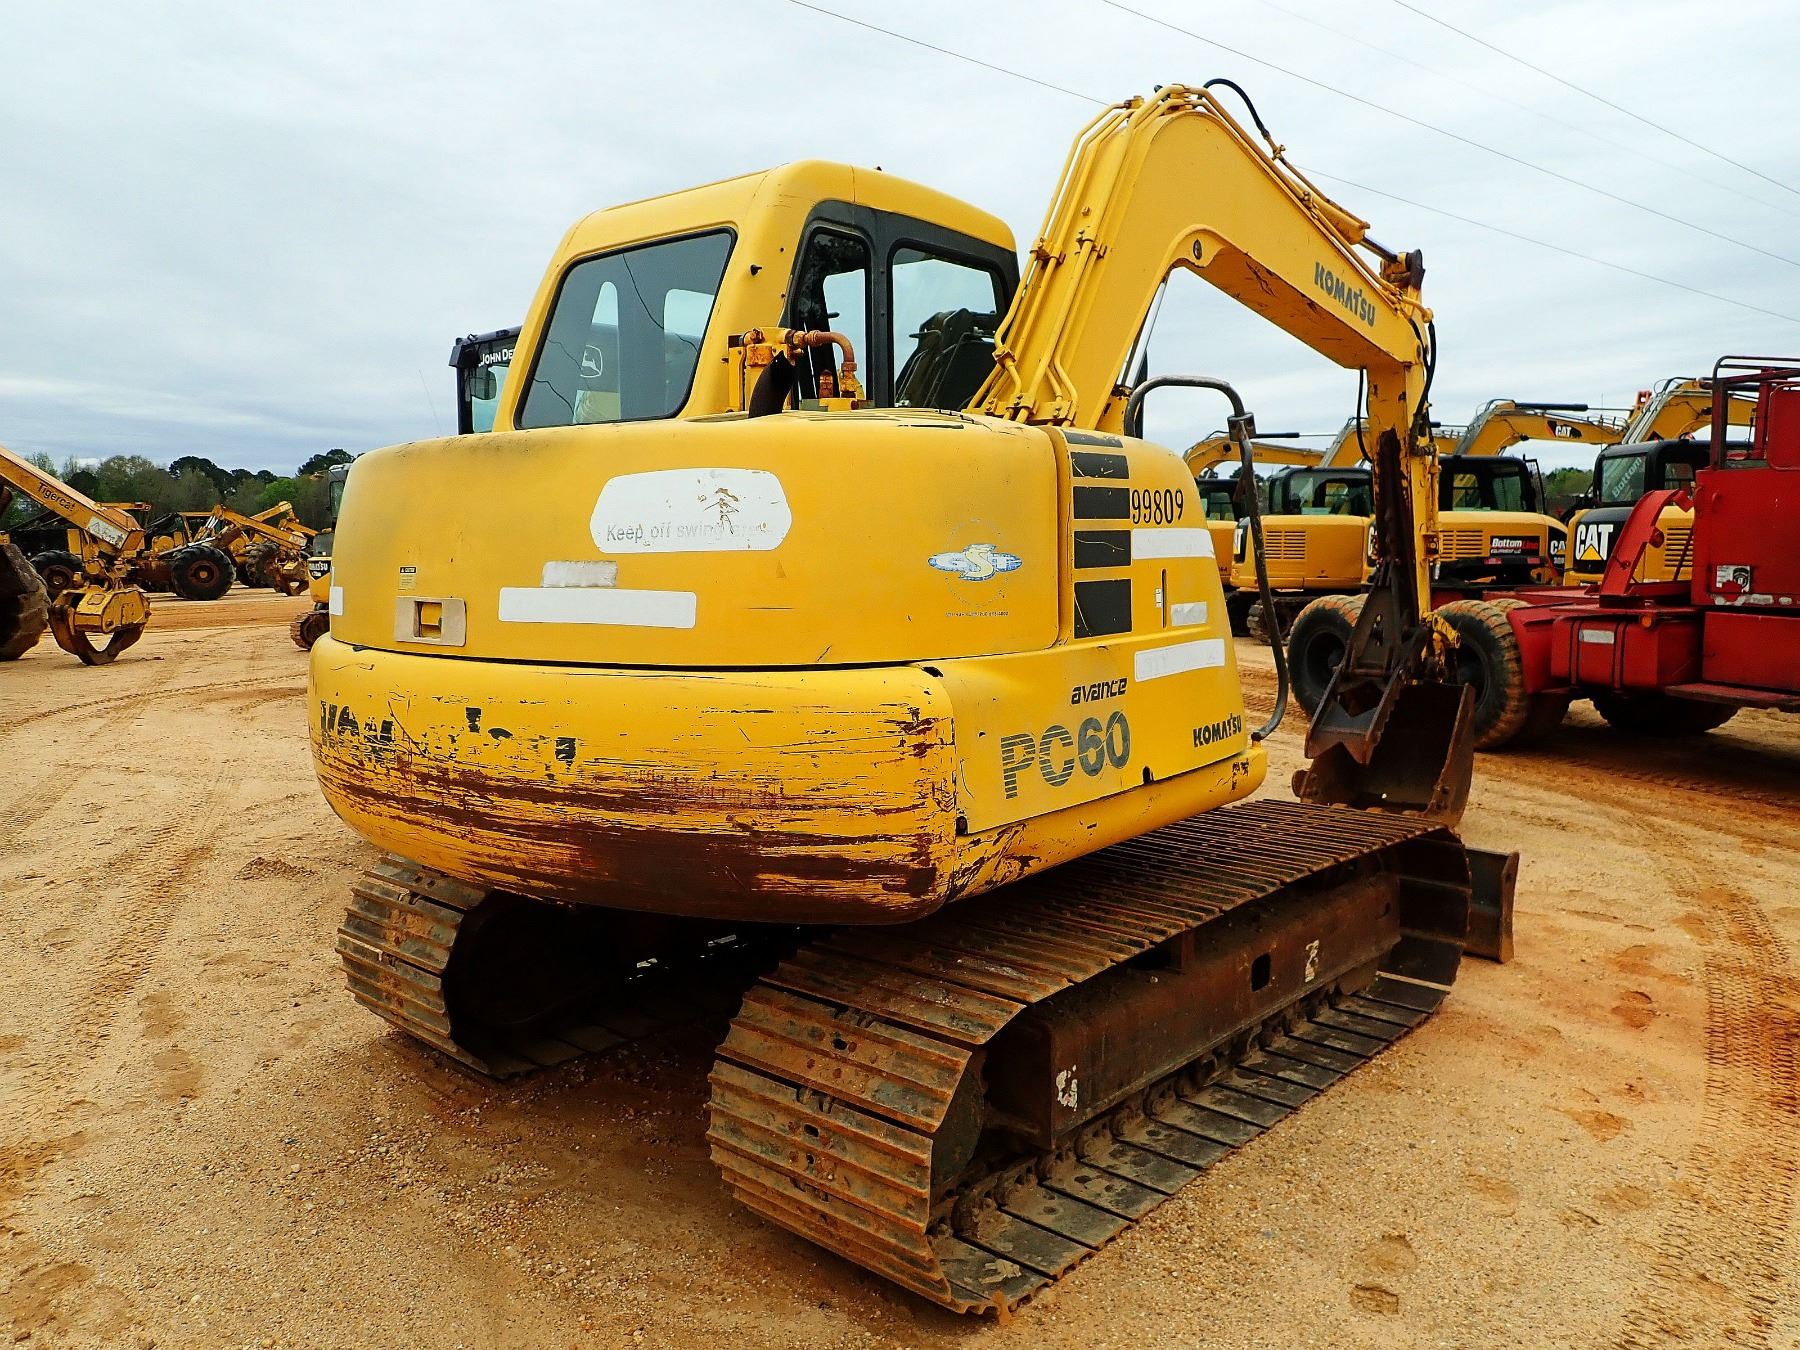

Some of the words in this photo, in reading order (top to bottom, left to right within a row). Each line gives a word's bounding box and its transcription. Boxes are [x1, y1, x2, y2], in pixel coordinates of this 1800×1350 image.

[1314, 261, 1376, 327] KOMATSU
[478, 351, 502, 367] JOHN
[501, 348, 516, 361] DE
[1555, 425, 1572, 438] CAT
[37, 482, 77, 512] Tigercat
[1131, 488, 1184, 525] 99809
[607, 523, 644, 543] Keep
[650, 521, 672, 538] off
[1491, 537, 1523, 548] Bottom
[1575, 523, 1614, 561] CAT
[1550, 540, 1566, 555] CA
[1071, 677, 1128, 705] avance
[1192, 712, 1242, 748] KOMATSU
[1000, 710, 1131, 800] PC60
